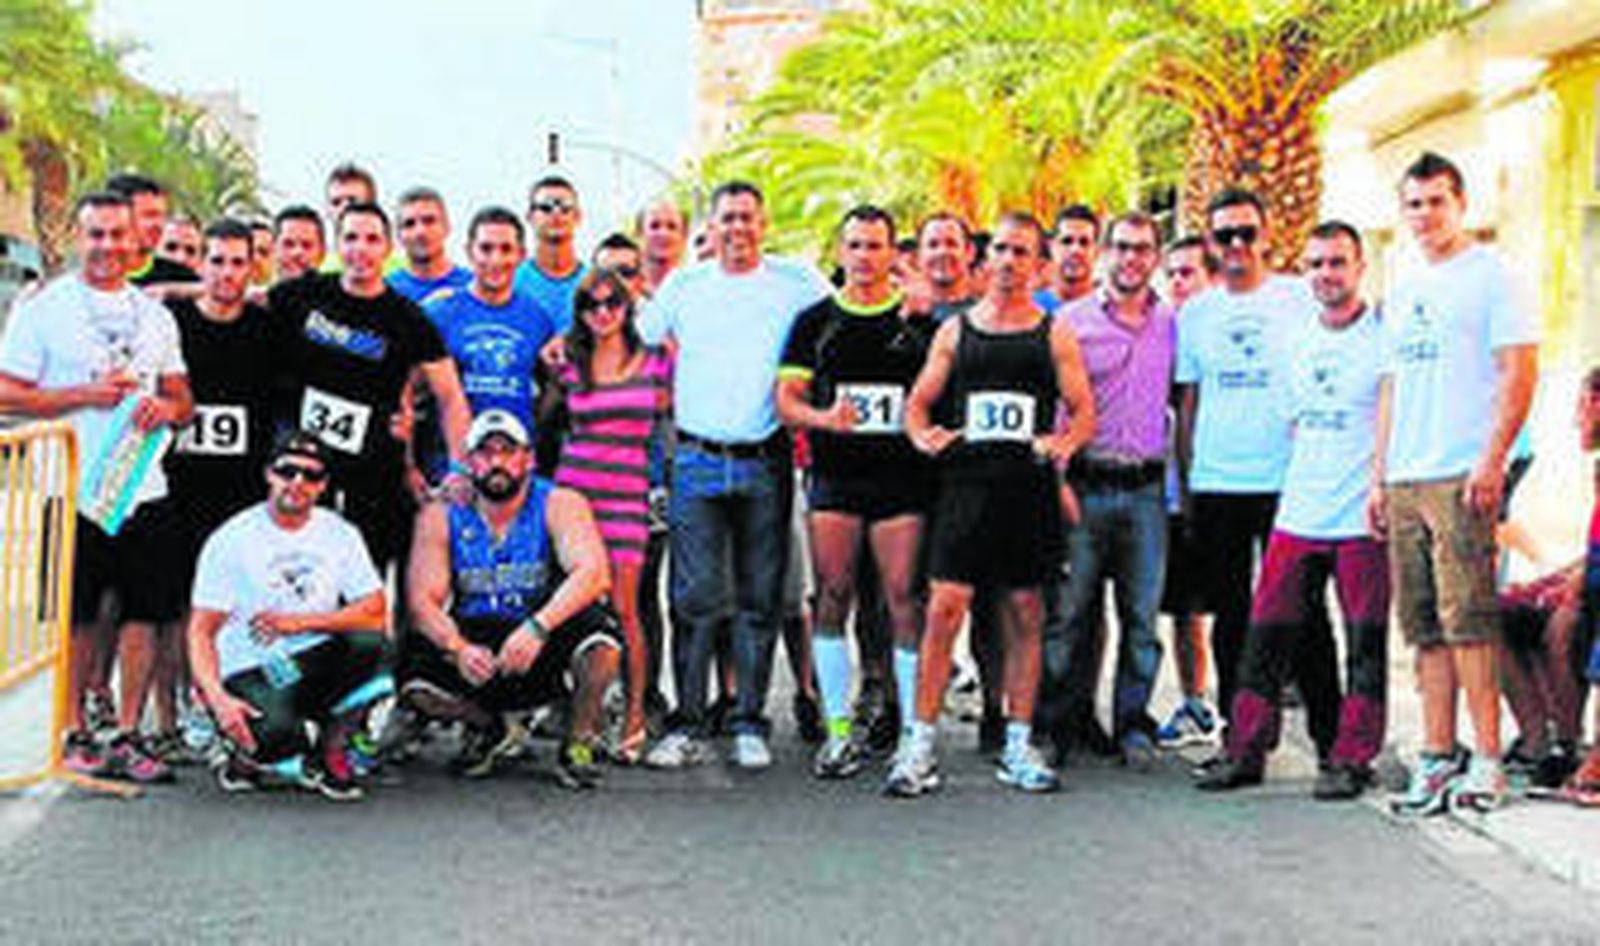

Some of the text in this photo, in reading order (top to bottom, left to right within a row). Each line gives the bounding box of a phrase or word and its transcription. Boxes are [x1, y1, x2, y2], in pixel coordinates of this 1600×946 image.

[307, 402, 356, 440] 34
[854, 394, 892, 425] 31
[975, 401, 1023, 431] 30
[192, 412, 240, 447] 19
